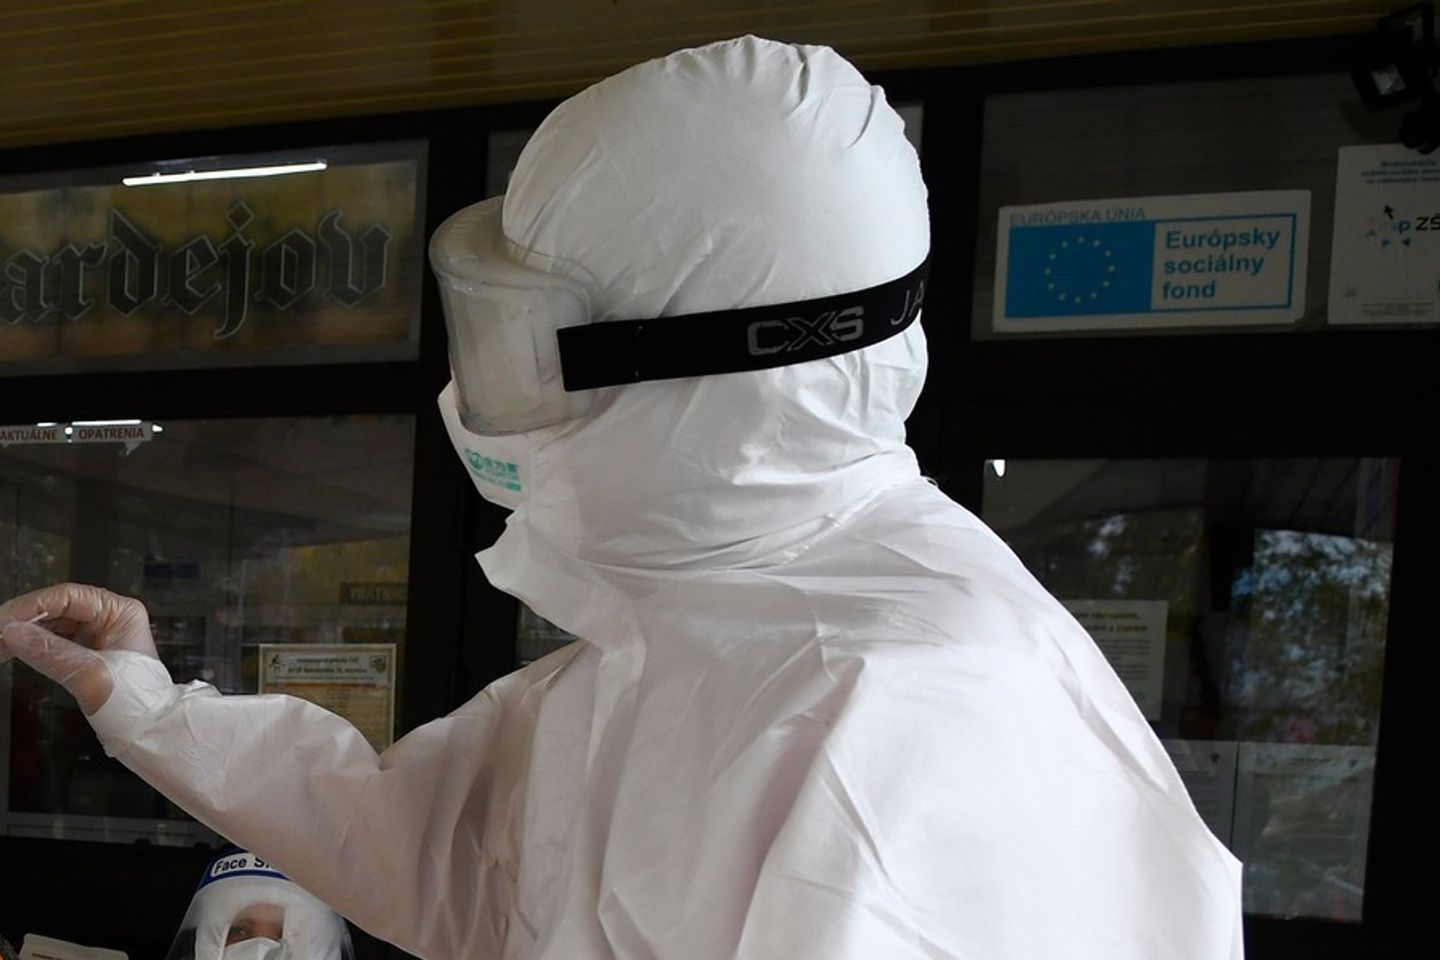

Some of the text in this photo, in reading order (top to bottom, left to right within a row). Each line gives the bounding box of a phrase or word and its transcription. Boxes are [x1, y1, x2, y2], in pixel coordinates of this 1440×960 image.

[1010, 206, 1147, 225] EURÓPSKA ÚNIA
[1165, 227, 1281, 251] Európsky
[1163, 254, 1265, 277] sociálny
[1162, 281, 1216, 300] fond
[746, 305, 864, 357] CXS
[0, 427, 145, 441] AKTUÁLNE OPATRENIA
[214, 858, 247, 874] Face
